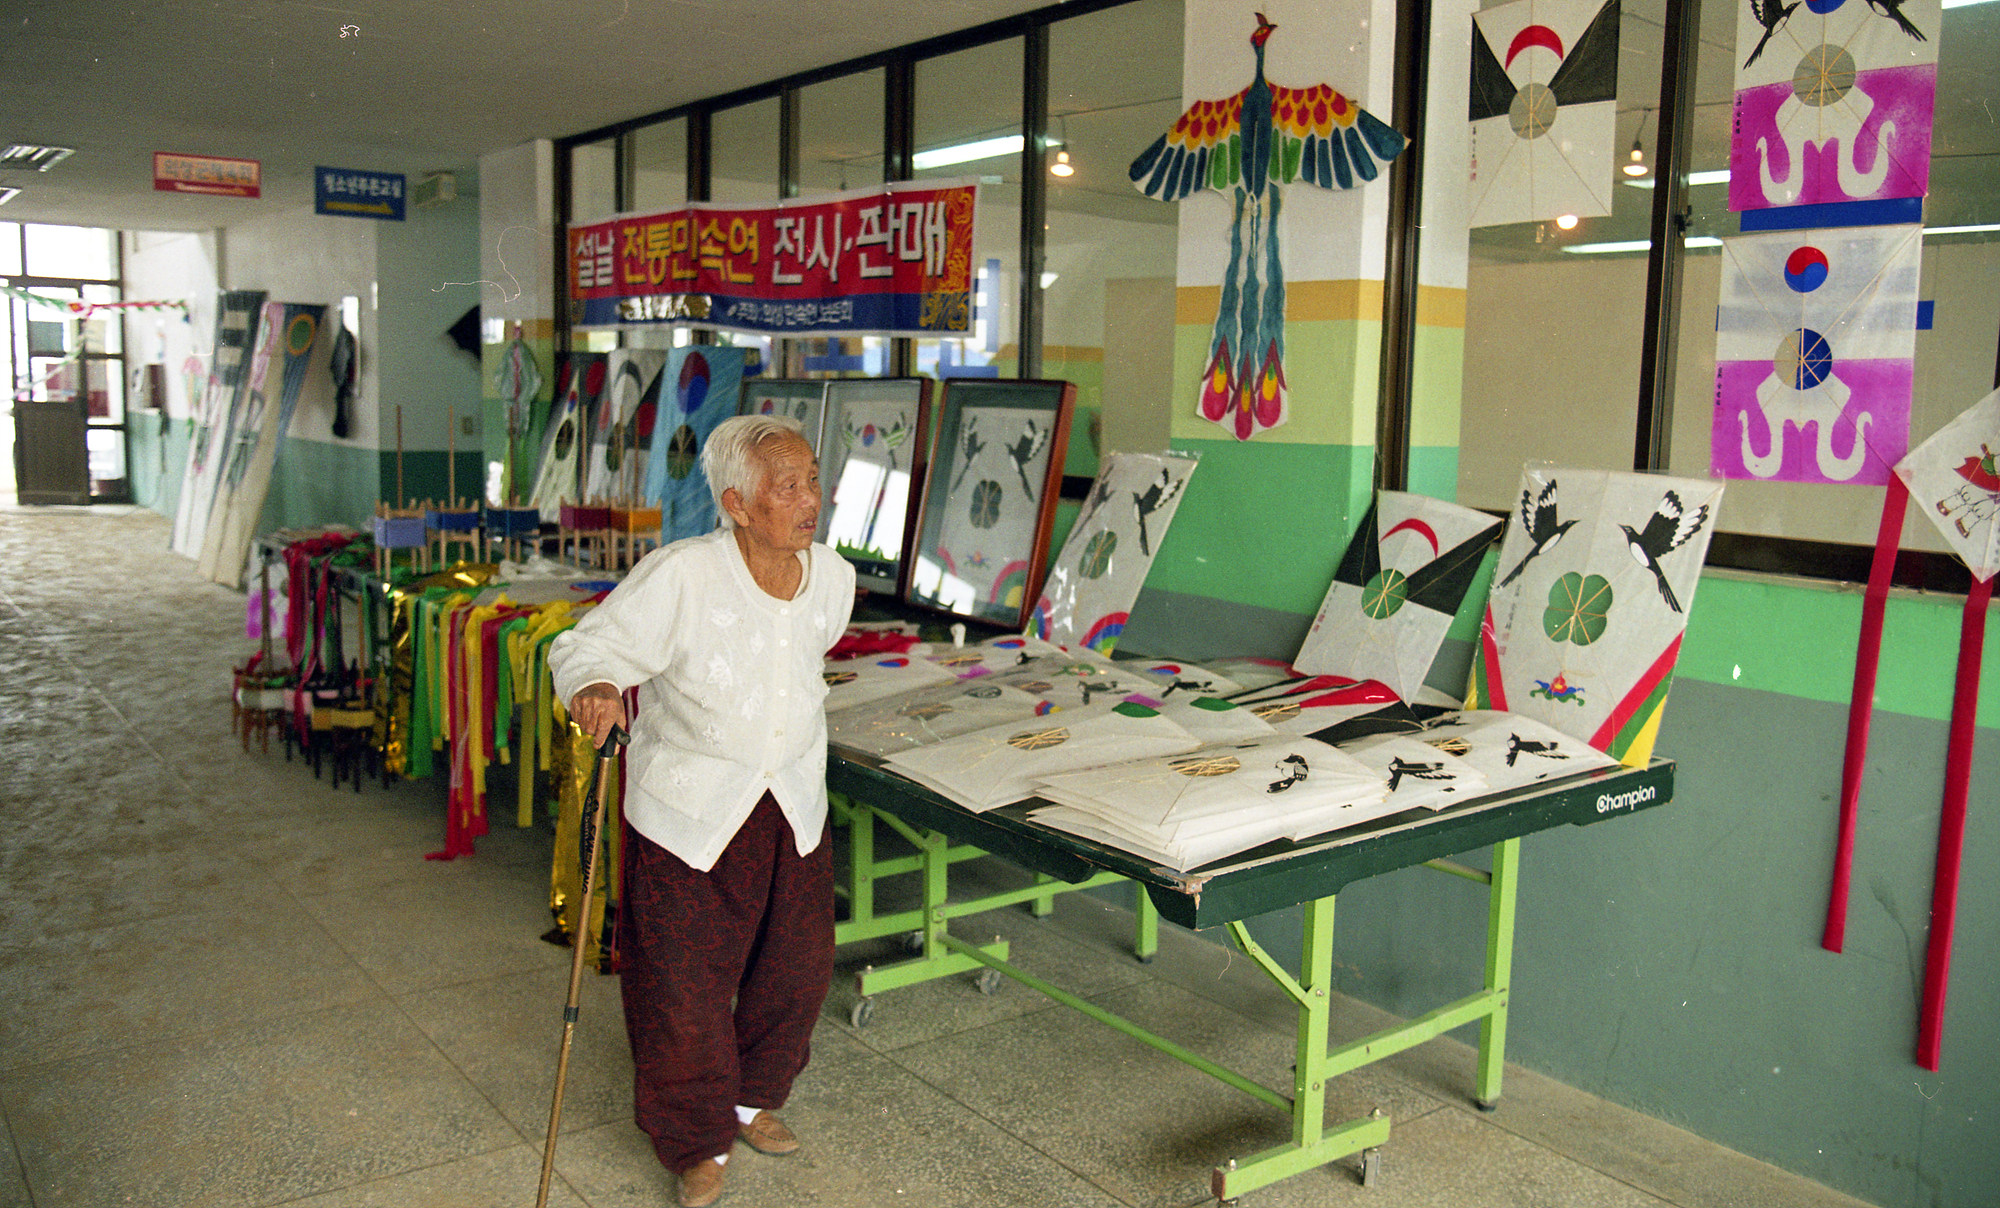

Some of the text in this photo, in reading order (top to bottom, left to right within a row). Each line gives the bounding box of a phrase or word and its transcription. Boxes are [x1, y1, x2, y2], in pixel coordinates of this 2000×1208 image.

[577, 229, 615, 288] 설날
[622, 218, 760, 285] 전통민속연
[1596, 785, 1655, 813] Champion
